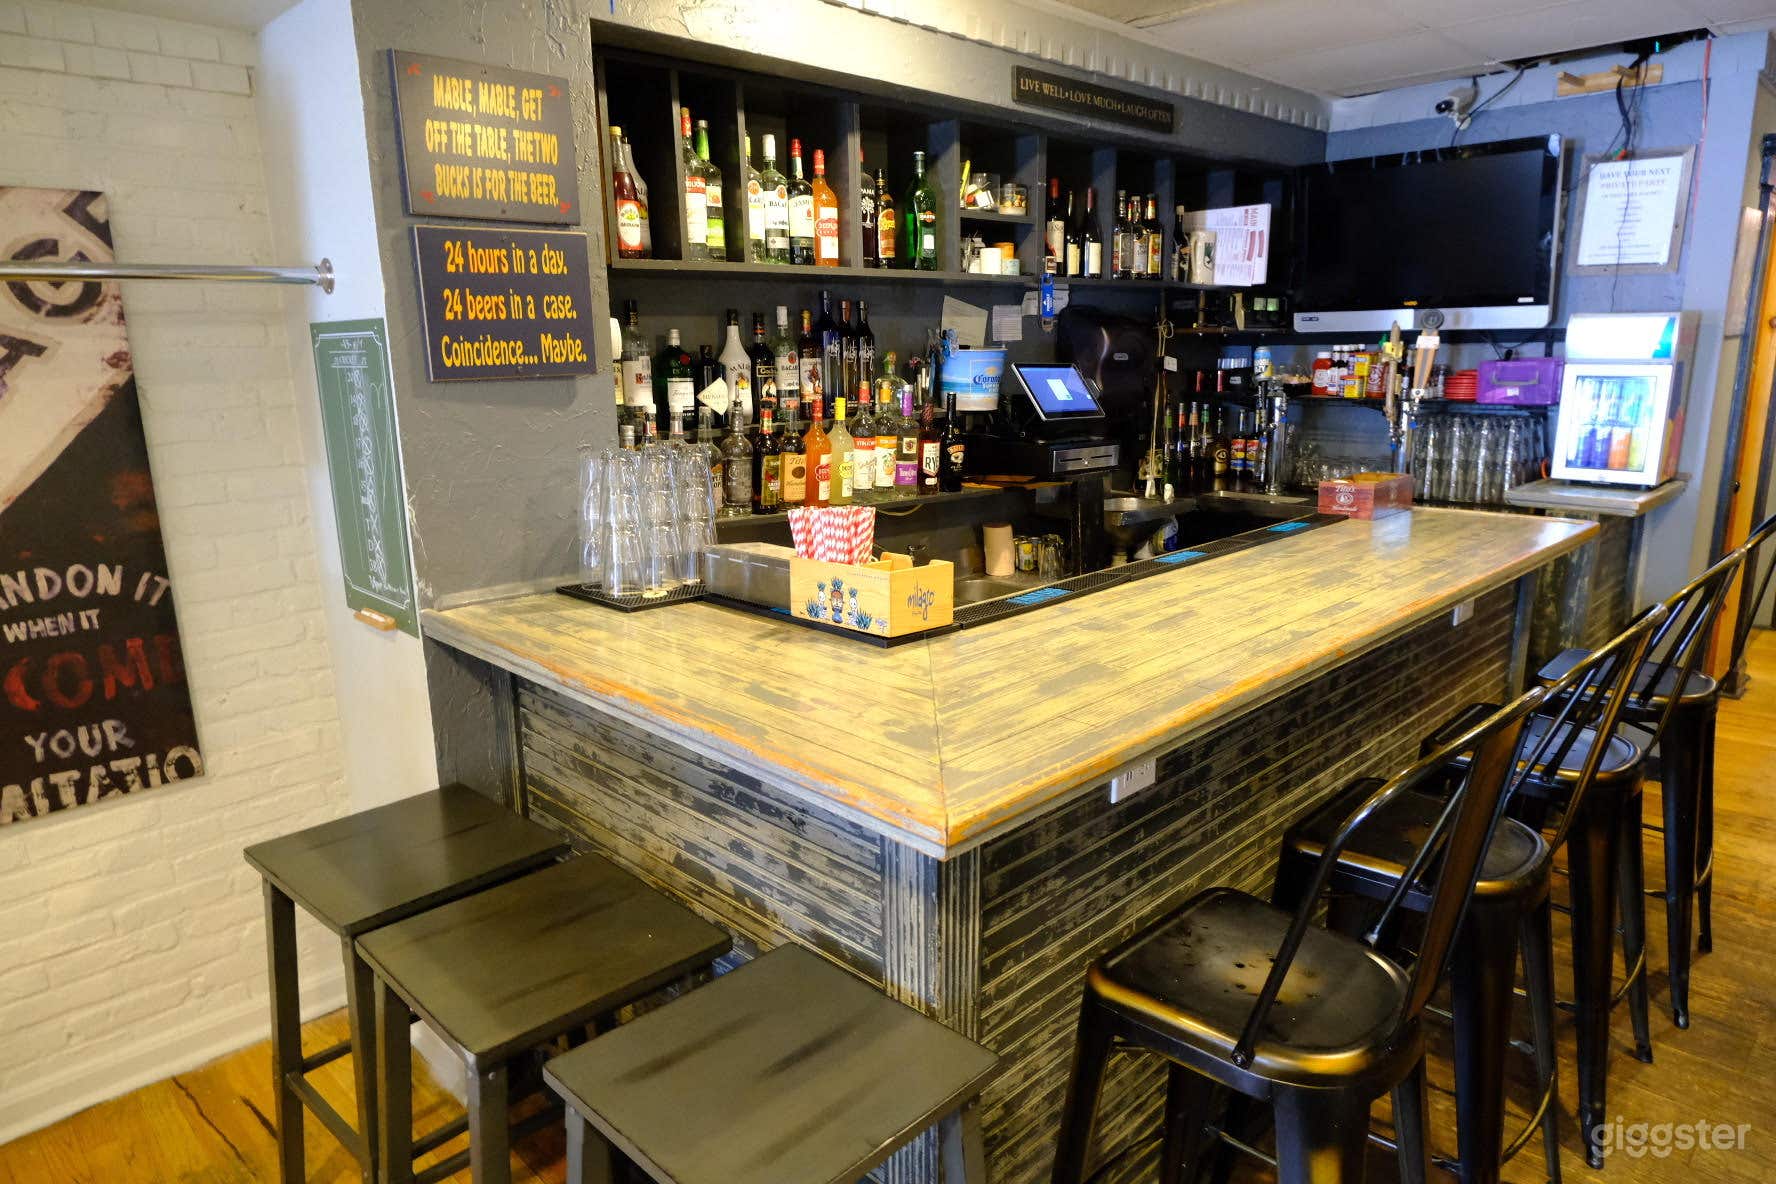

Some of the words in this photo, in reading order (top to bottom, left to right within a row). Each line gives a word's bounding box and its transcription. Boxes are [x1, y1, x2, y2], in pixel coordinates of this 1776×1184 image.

[522, 88, 543, 121] GET
[1020, 78, 1040, 92] LIVE
[1042, 82, 1064, 98] WELL
[1070, 89, 1092, 105] LOVE
[1094, 95, 1118, 110] MUCH
[1121, 103, 1148, 118] LAUGH
[425, 119, 447, 154] OFF
[450, 121, 472, 157] THE
[474, 124, 511, 164] TABLE,
[434, 163, 470, 199] BUCKS
[473, 167, 482, 199] IS
[485, 169, 508, 203] FOR
[508, 171, 528, 204] THE
[530, 172, 559, 207] BEER.
[444, 240, 464, 273] 24
[467, 240, 509, 274] hours
[512, 242, 525, 274] in
[528, 249, 538, 274] a
[541, 243, 568, 275] day.
[443, 288, 463, 320] 24
[466, 288, 506, 320] beers
[509, 289, 523, 320] in
[527, 294, 536, 320] a
[543, 294, 577, 320] case.
[441, 335, 539, 367] Coincidence...
[540, 333, 587, 363] Maybe.
[0, 564, 123, 610] NDON
[134, 571, 170, 607] IT
[2, 611, 75, 643] WHEN
[79, 609, 100, 631] IT
[24, 718, 136, 763] YOUR
